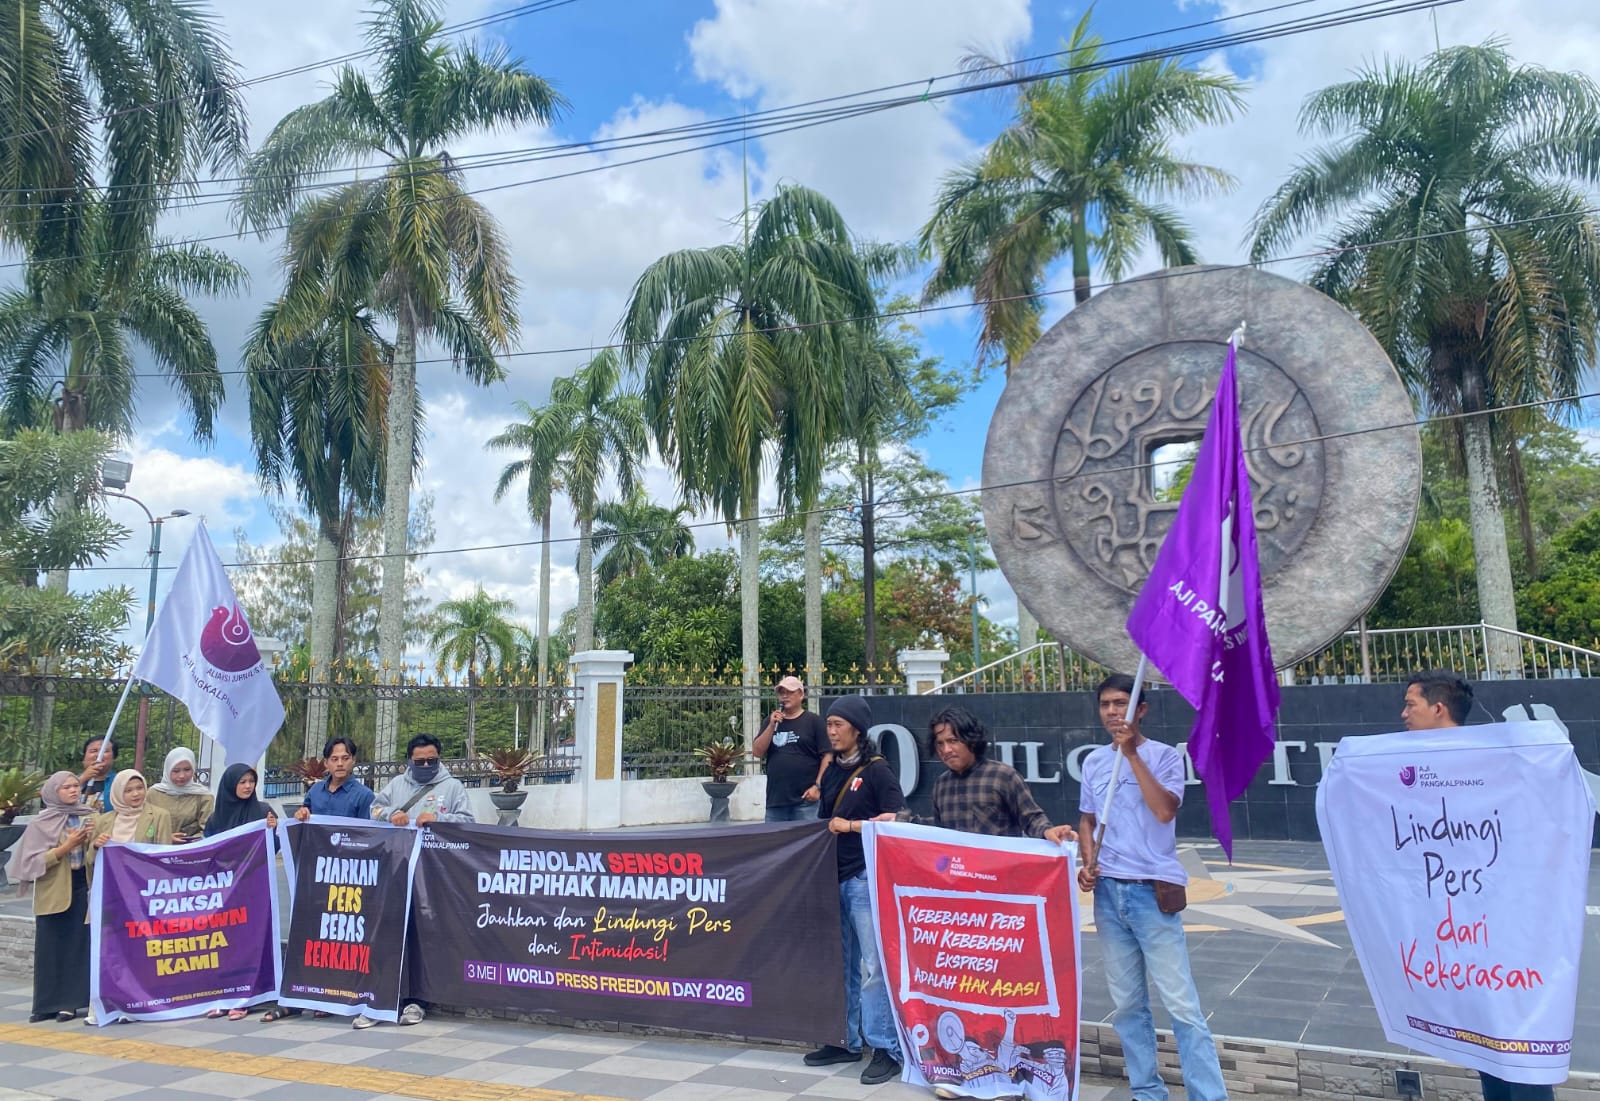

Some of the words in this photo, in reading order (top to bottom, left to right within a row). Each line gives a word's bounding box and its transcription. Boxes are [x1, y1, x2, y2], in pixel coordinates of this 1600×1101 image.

[1169, 580, 1196, 606] AJI
[1420, 779, 1485, 788] PANGKALPINANG
[1391, 797, 1503, 868] Lindungi
[315, 856, 379, 886] BIARKAN
[499, 849, 606, 874] MENOLAK
[608, 852, 704, 876] SENSOR
[1423, 852, 1483, 899] Pers
[140, 870, 234, 897] JANGAN
[477, 872, 527, 894] DARI
[529, 874, 596, 897] PIHAK
[599, 877, 727, 903] MANAPUN!
[148, 891, 224, 916] PAKSA
[327, 885, 362, 914] PERS
[125, 906, 248, 938] TAKEDOWN
[320, 912, 365, 943] BEBAS
[476, 903, 547, 929] Jauhkan
[553, 909, 586, 930] dan
[593, 907, 678, 941] Lindungi
[686, 907, 732, 934] Pers
[908, 905, 987, 928] KEBEBASAN
[990, 912, 1026, 931] PERS
[1436, 897, 1489, 948] dari
[146, 930, 228, 957] BERITA
[528, 934, 561, 956] dari
[567, 934, 669, 962] Intimidasi!
[913, 926, 939, 945] DAN
[940, 929, 1024, 954] KEBEBASAN
[156, 952, 219, 976] KAMI
[304, 939, 371, 974] BERKARYA
[935, 952, 999, 973] EKSPRESI
[1399, 938, 1544, 992] Kekerasan
[467, 964, 476, 979] 3
[477, 964, 497, 981] MEI
[506, 968, 555, 986] WORLD
[556, 972, 598, 991] PRESS
[600, 977, 671, 997] FREEDOM
[672, 982, 703, 1000] DAY
[706, 983, 745, 1003] 2026
[914, 968, 957, 989] ADALAH
[959, 975, 989, 996] HAK
[990, 979, 1040, 997] ASASI
[147, 998, 171, 1007] WORLD
[171, 994, 193, 1002] PRESS
[1428, 1023, 1457, 1038] WORLD
[1456, 1031, 1482, 1045] PRESS
[1482, 1037, 1529, 1052] FREEDOM
[1531, 1043, 1555, 1053] DAY
[933, 1066, 961, 1077] WORLD
